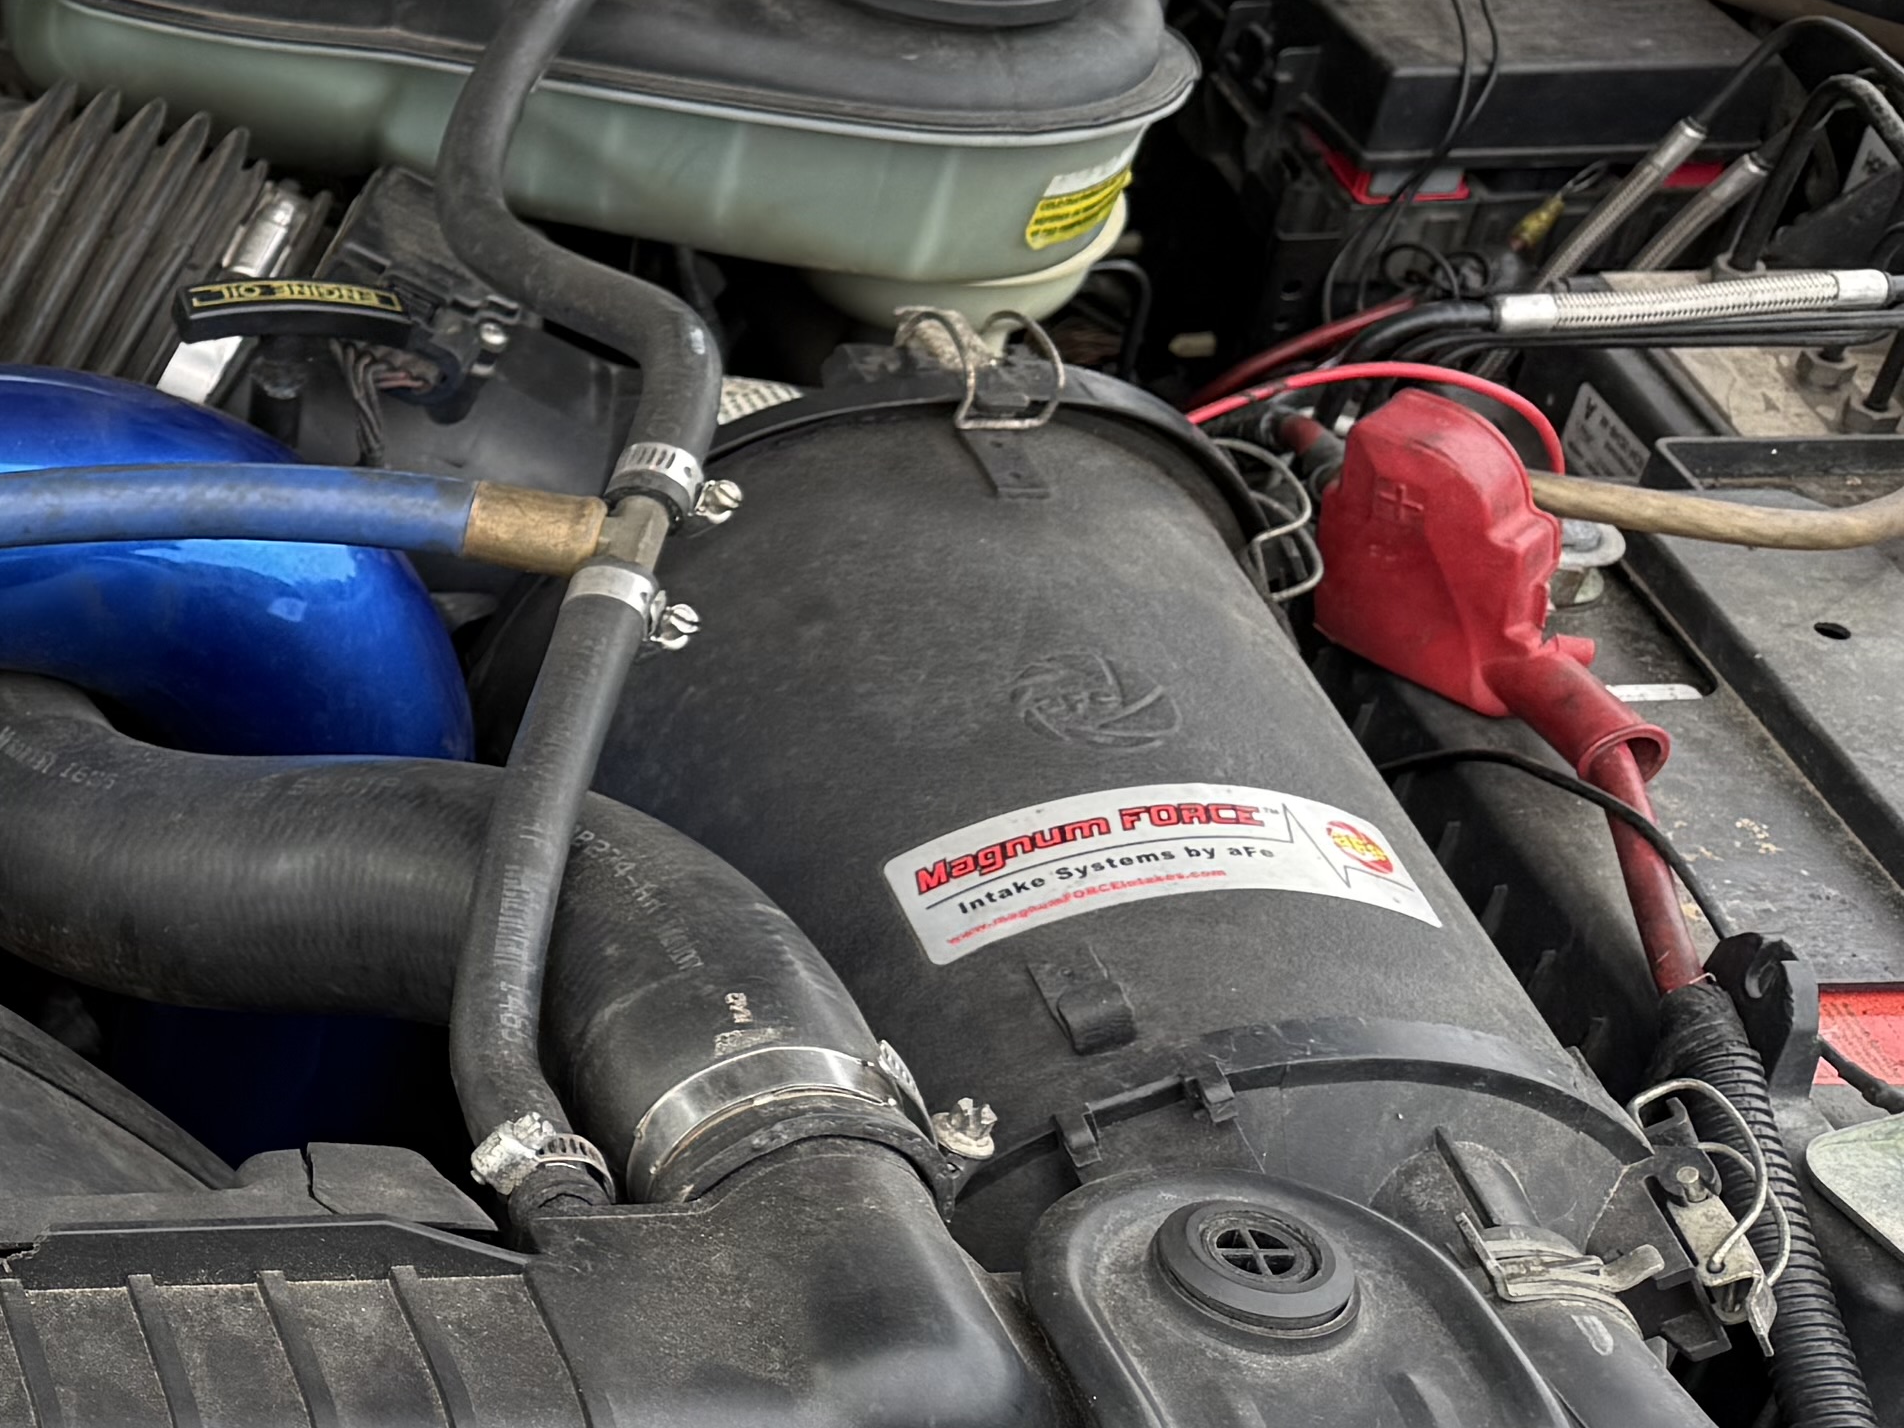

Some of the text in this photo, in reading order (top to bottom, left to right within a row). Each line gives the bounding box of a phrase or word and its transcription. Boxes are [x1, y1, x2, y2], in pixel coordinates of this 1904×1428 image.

[915, 815, 1111, 896] Magnum
[1118, 802, 1265, 832] FORCE
[958, 844, 1275, 915] Intake Systems by aFe
